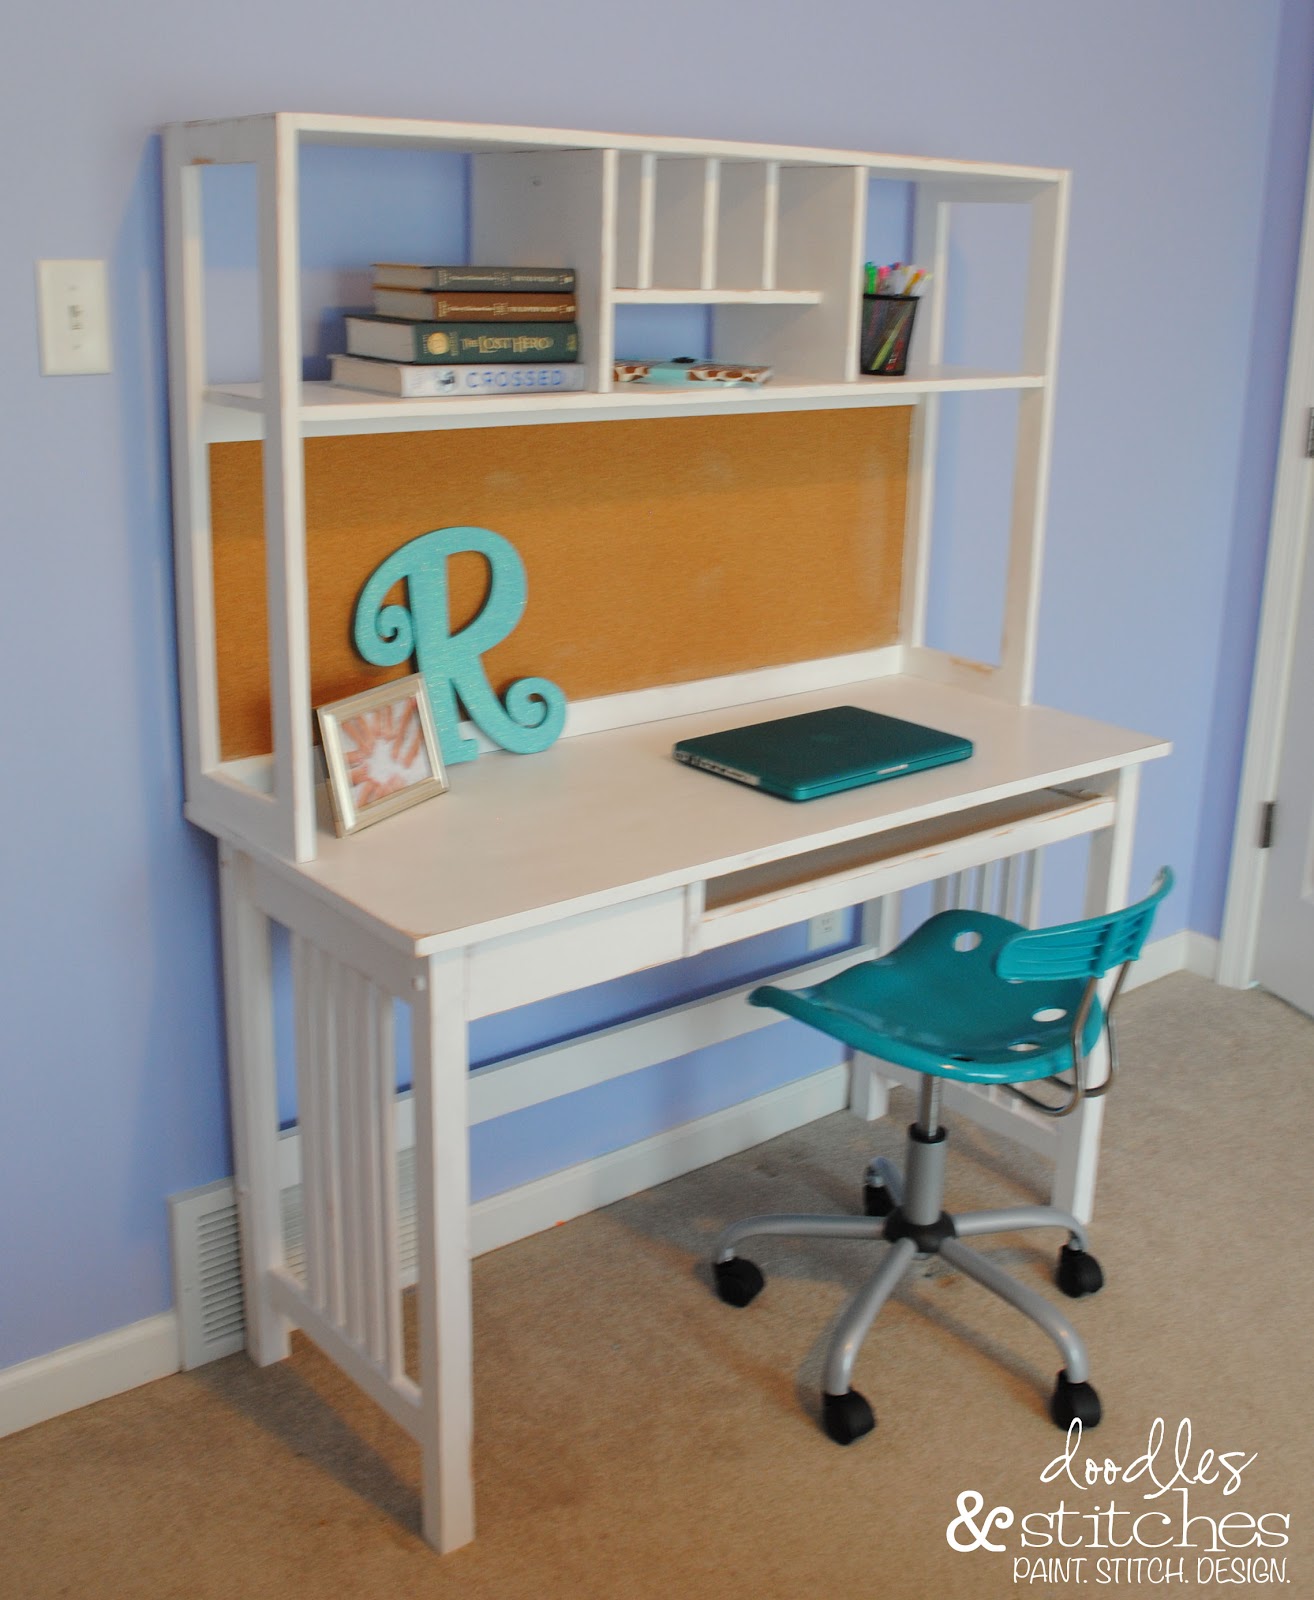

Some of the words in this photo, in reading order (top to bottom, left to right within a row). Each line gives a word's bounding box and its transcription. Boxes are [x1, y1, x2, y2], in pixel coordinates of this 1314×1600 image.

[478, 335, 509, 354] LOST
[512, 335, 554, 353] HERO
[465, 369, 566, 388] CROSSED
[353, 526, 567, 766] R
